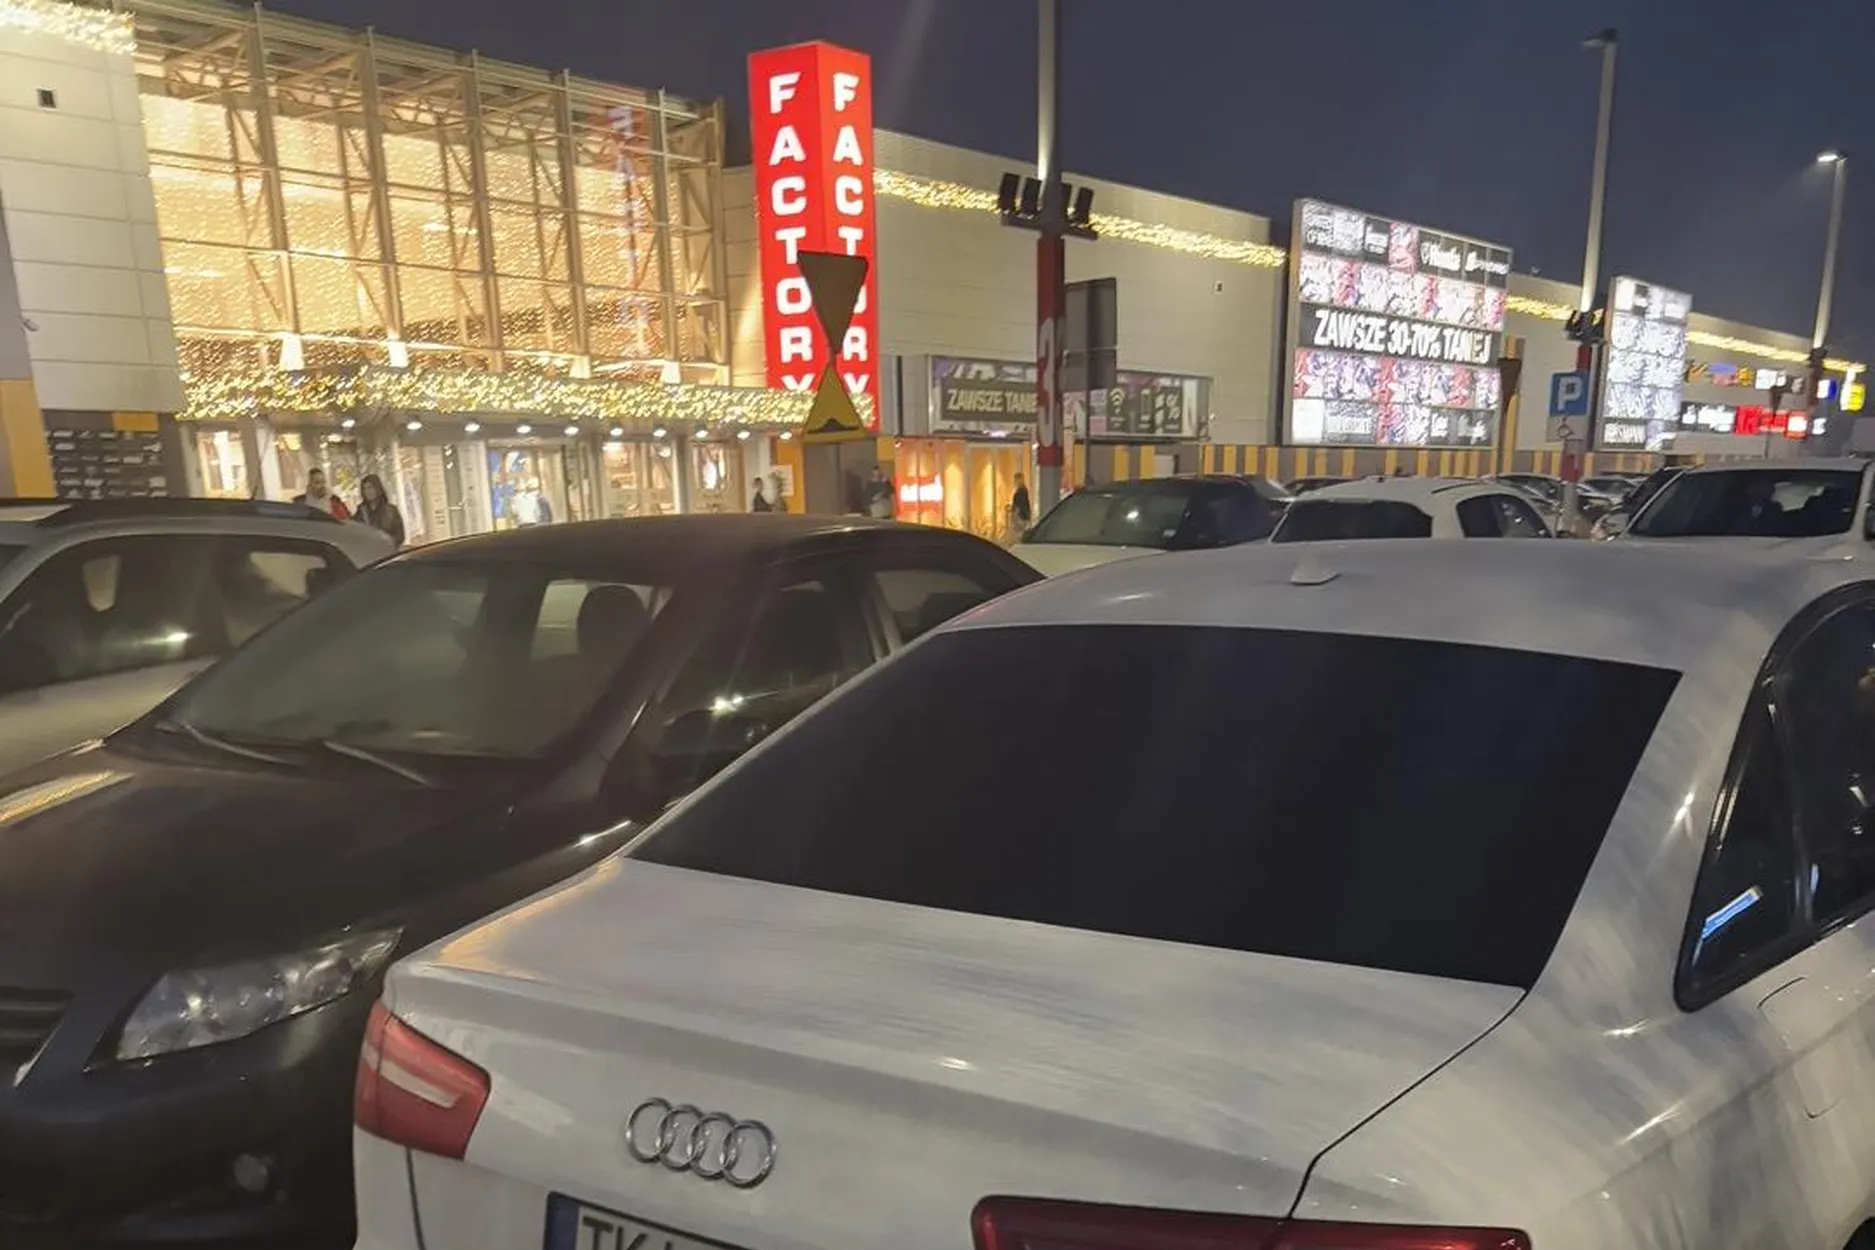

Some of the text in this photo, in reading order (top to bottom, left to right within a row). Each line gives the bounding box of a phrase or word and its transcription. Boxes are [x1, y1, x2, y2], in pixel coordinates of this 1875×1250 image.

[832, 71, 870, 394] FACTRY
[1313, 308, 1388, 352] ZAWSZE
[1442, 327, 1493, 365] TANIEJ
[946, 388, 1004, 412] ZAWSZE
[1557, 376, 1582, 411] P
